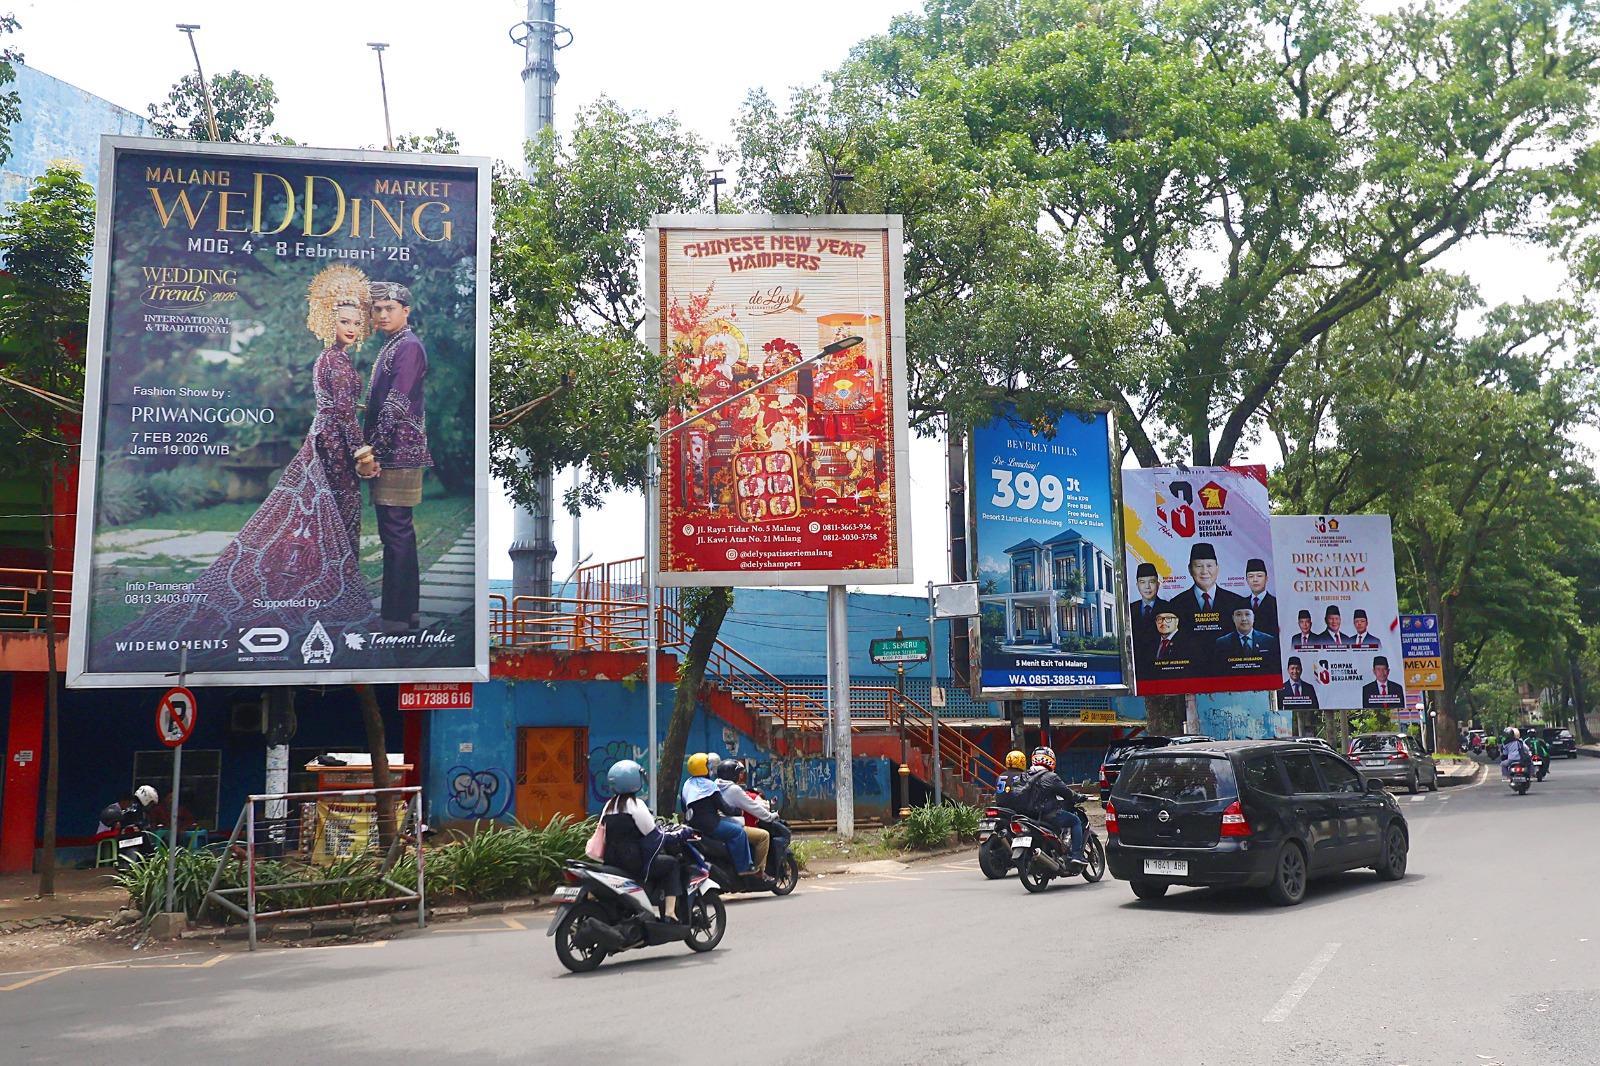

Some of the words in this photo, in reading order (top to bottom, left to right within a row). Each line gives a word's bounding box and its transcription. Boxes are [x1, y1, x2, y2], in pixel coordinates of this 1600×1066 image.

[145, 166, 231, 187] MALANG
[375, 179, 452, 198] MARKET
[147, 172, 453, 243] WEDDING
[241, 239, 252, 255] 4
[276, 241, 287, 256] 8
[295, 243, 376, 261] Februari
[683, 235, 765, 258] CHINESE
[770, 235, 812, 251] NEW
[817, 238, 867, 259] YEAR
[728, 252, 821, 273] HAMPERS
[142, 266, 238, 287] WEDDING
[147, 283, 207, 303] Trends
[212, 291, 238, 303] 2026
[748, 290, 763, 305] de
[763, 285, 792, 309] Lys
[144, 314, 232, 326] INTERNATIONAL
[145, 323, 154, 332] &
[155, 323, 229, 335] TRADITIONAL
[133, 386, 176, 396] Fashion
[179, 387, 209, 397] Show
[212, 388, 225, 399] by
[131, 406, 275, 424] PRIWANGGONO
[131, 432, 139, 443] 7
[143, 432, 172, 443] FEB
[175, 432, 209, 443] 2026
[130, 445, 158, 455] Jam
[163, 445, 199, 455] 19.00
[203, 445, 230, 455] WIB
[1007, 439, 1048, 453] BEVERLY
[1051, 445, 1078, 457] HILLS
[991, 469, 1064, 512] 399
[1066, 477, 1081, 492] Jt
[982, 512, 1001, 521] Resort
[1042, 519, 1062, 528] Malang
[696, 525, 706, 534] Jl.
[707, 526, 727, 535] Raya
[728, 525, 750, 533] Tidar
[772, 524, 801, 534] Malang
[822, 523, 872, 532] 0811-3663-936
[696, 536, 706, 545] Jl.
[707, 536, 728, 544] Kawi
[772, 535, 802, 544] Malang
[822, 533, 878, 542] 0812-3030-3758
[739, 549, 833, 559] @delyspatisseriemalang
[1291, 552, 1368, 564] DIRGAHAYU
[739, 560, 801, 570] @delyshampers
[1305, 565, 1356, 578] PARTAI
[125, 581, 146, 591] Info
[147, 581, 195, 592] Pameran
[1293, 580, 1370, 592] GERINDRA
[124, 594, 152, 604] 0813
[154, 594, 181, 604] 3403
[182, 593, 209, 603] 0777
[252, 598, 306, 611] Supported
[307, 598, 320, 609] by
[369, 632, 417, 645] Taman
[420, 629, 456, 644] Indie
[115, 638, 229, 652] WIDEMOMENTS
[1065, 660, 1088, 668] Malang
[1404, 660, 1440, 669] MEVAL
[1008, 674, 1027, 684] WA
[1028, 674, 1096, 685] 0851-3885-3141
[401, 692, 421, 706] 081
[424, 692, 450, 705] 7388
[451, 692, 471, 704] 616
[1146, 860, 1150, 868] N
[1154, 860, 1170, 870] 1841
